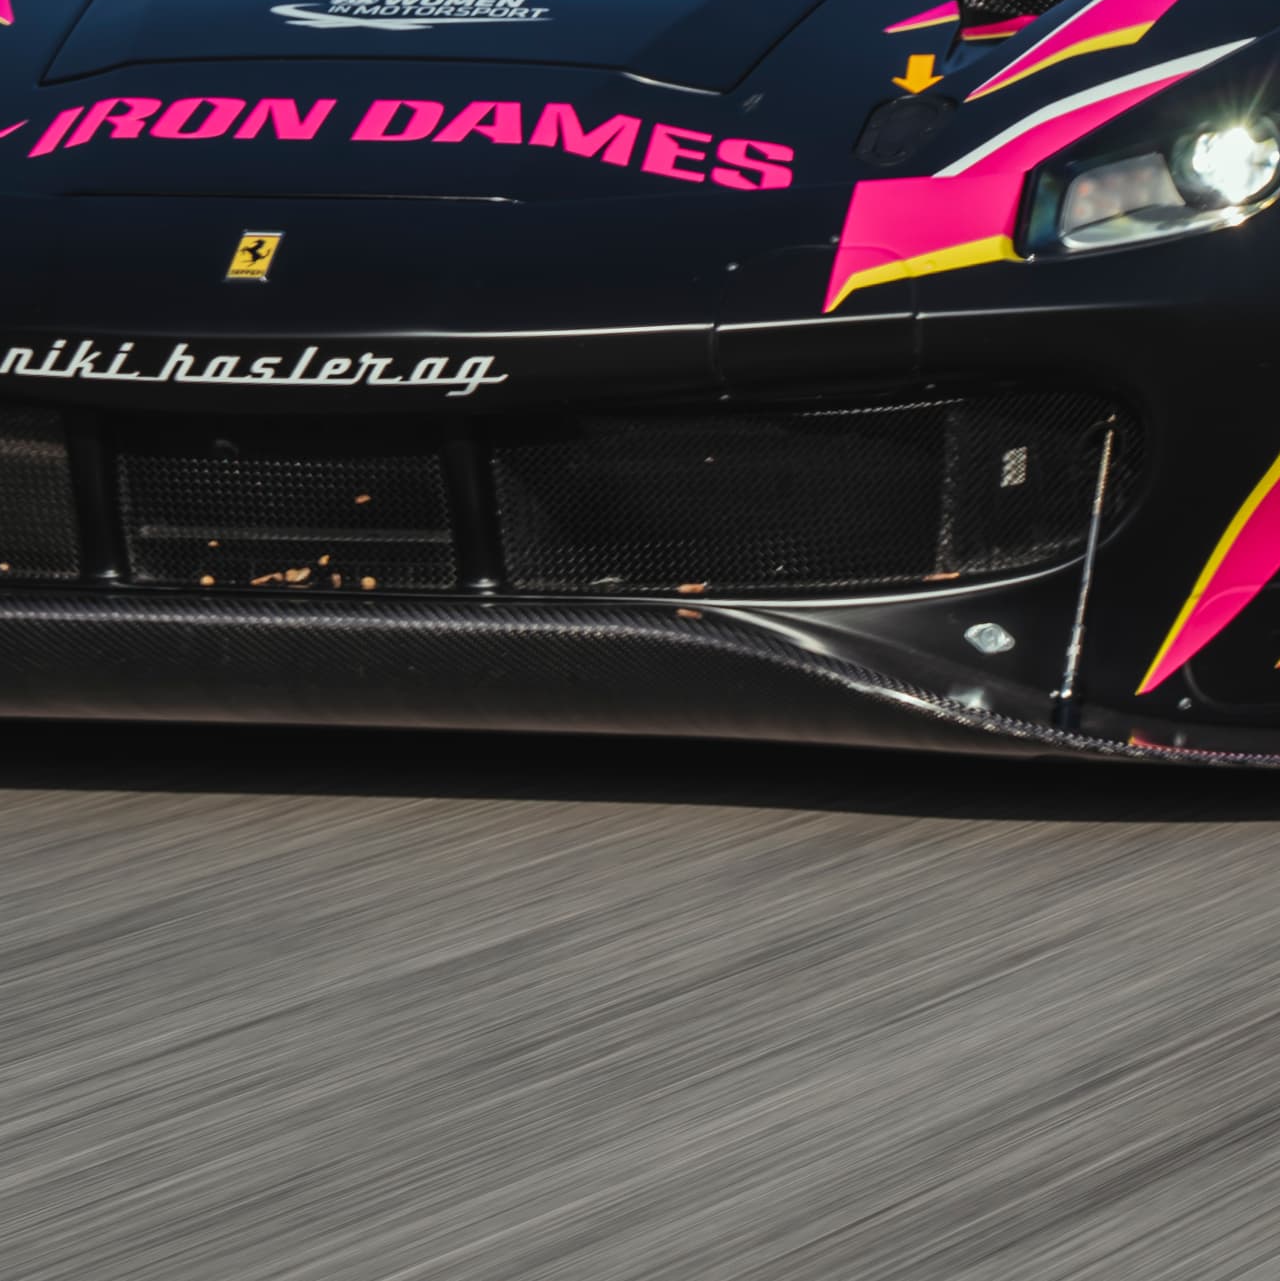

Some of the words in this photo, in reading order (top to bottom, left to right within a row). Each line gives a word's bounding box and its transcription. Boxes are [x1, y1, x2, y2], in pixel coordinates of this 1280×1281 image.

[327, 5, 352, 14] IN
[352, 5, 550, 19] MOTORSPORT
[28, 97, 336, 158] IRON
[351, 100, 795, 191] DAMES
